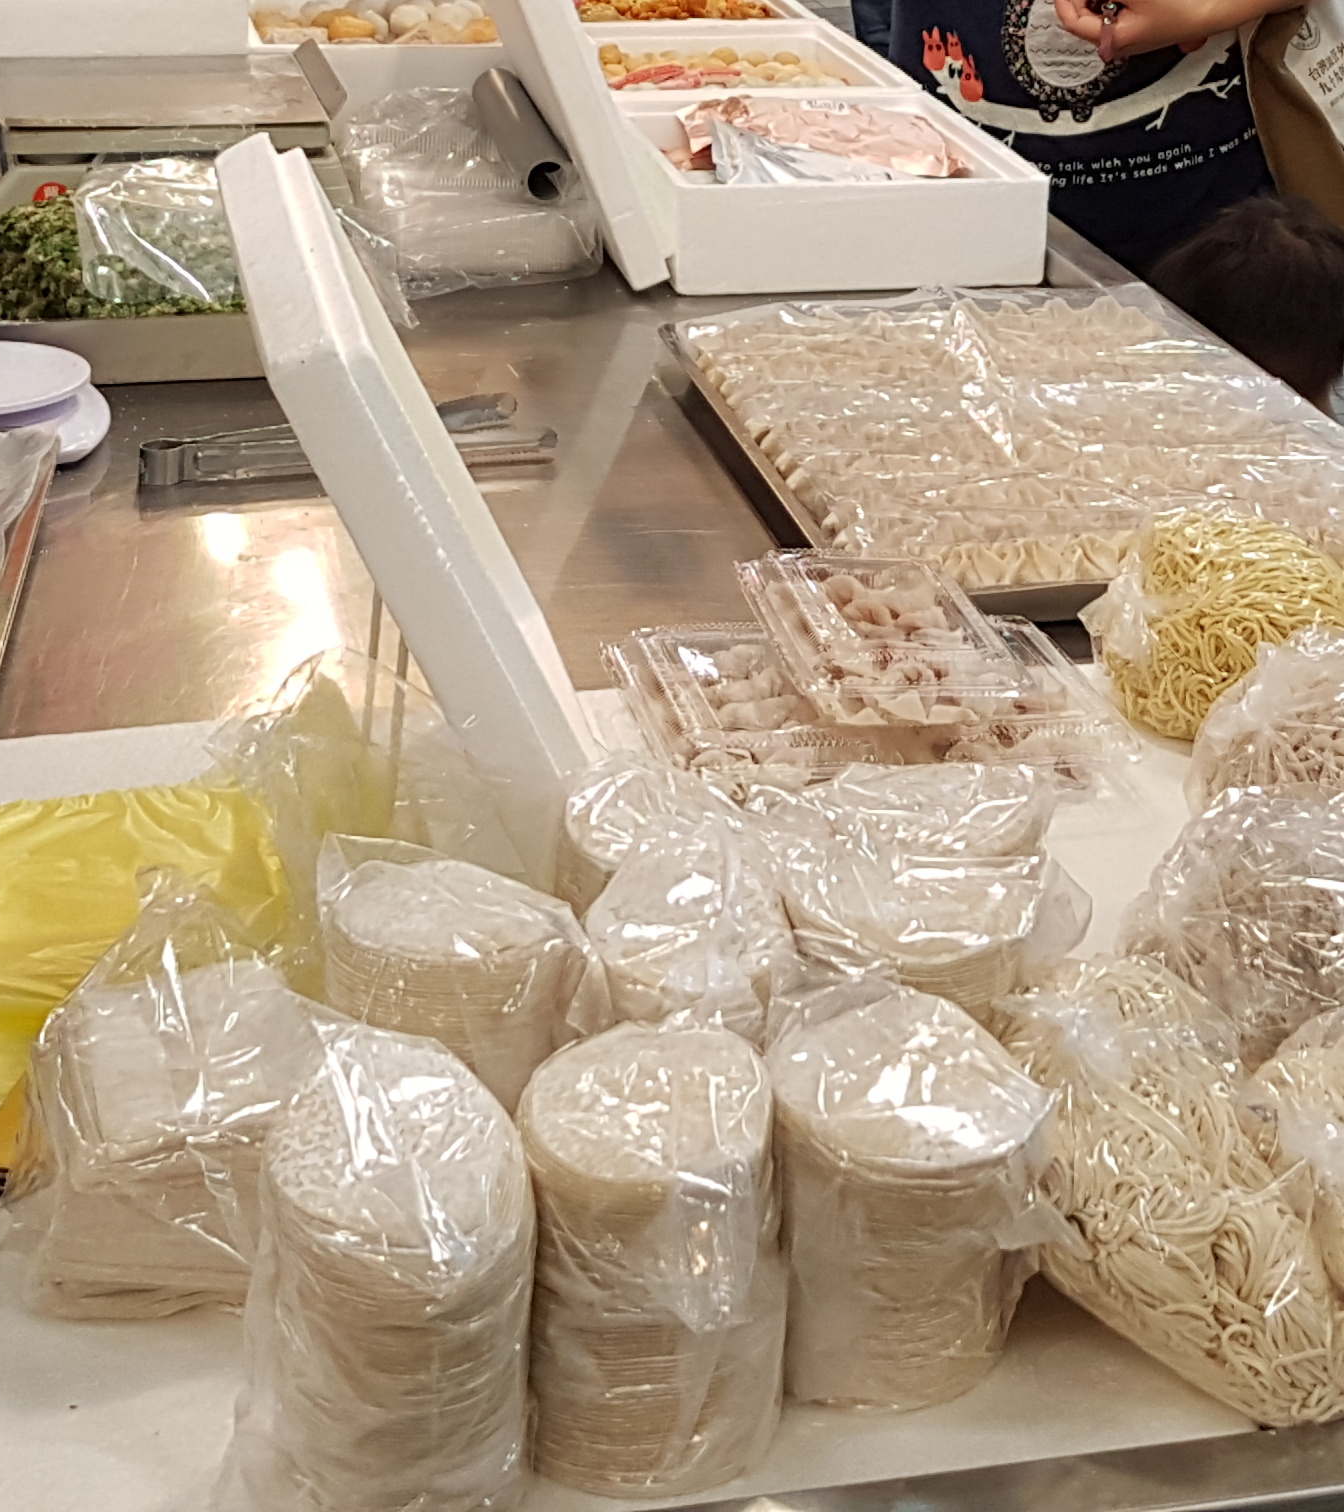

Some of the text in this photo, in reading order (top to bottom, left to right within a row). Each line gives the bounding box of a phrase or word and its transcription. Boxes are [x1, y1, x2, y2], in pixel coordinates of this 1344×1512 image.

[1058, 161, 1084, 172] talk
[1128, 153, 1151, 167] you
[1157, 143, 1192, 161] again
[1072, 173, 1094, 186] life
[1133, 163, 1168, 179] seeds
[1173, 153, 1204, 170] while
[1209, 147, 1215, 158] I
[1219, 137, 1240, 154] was
